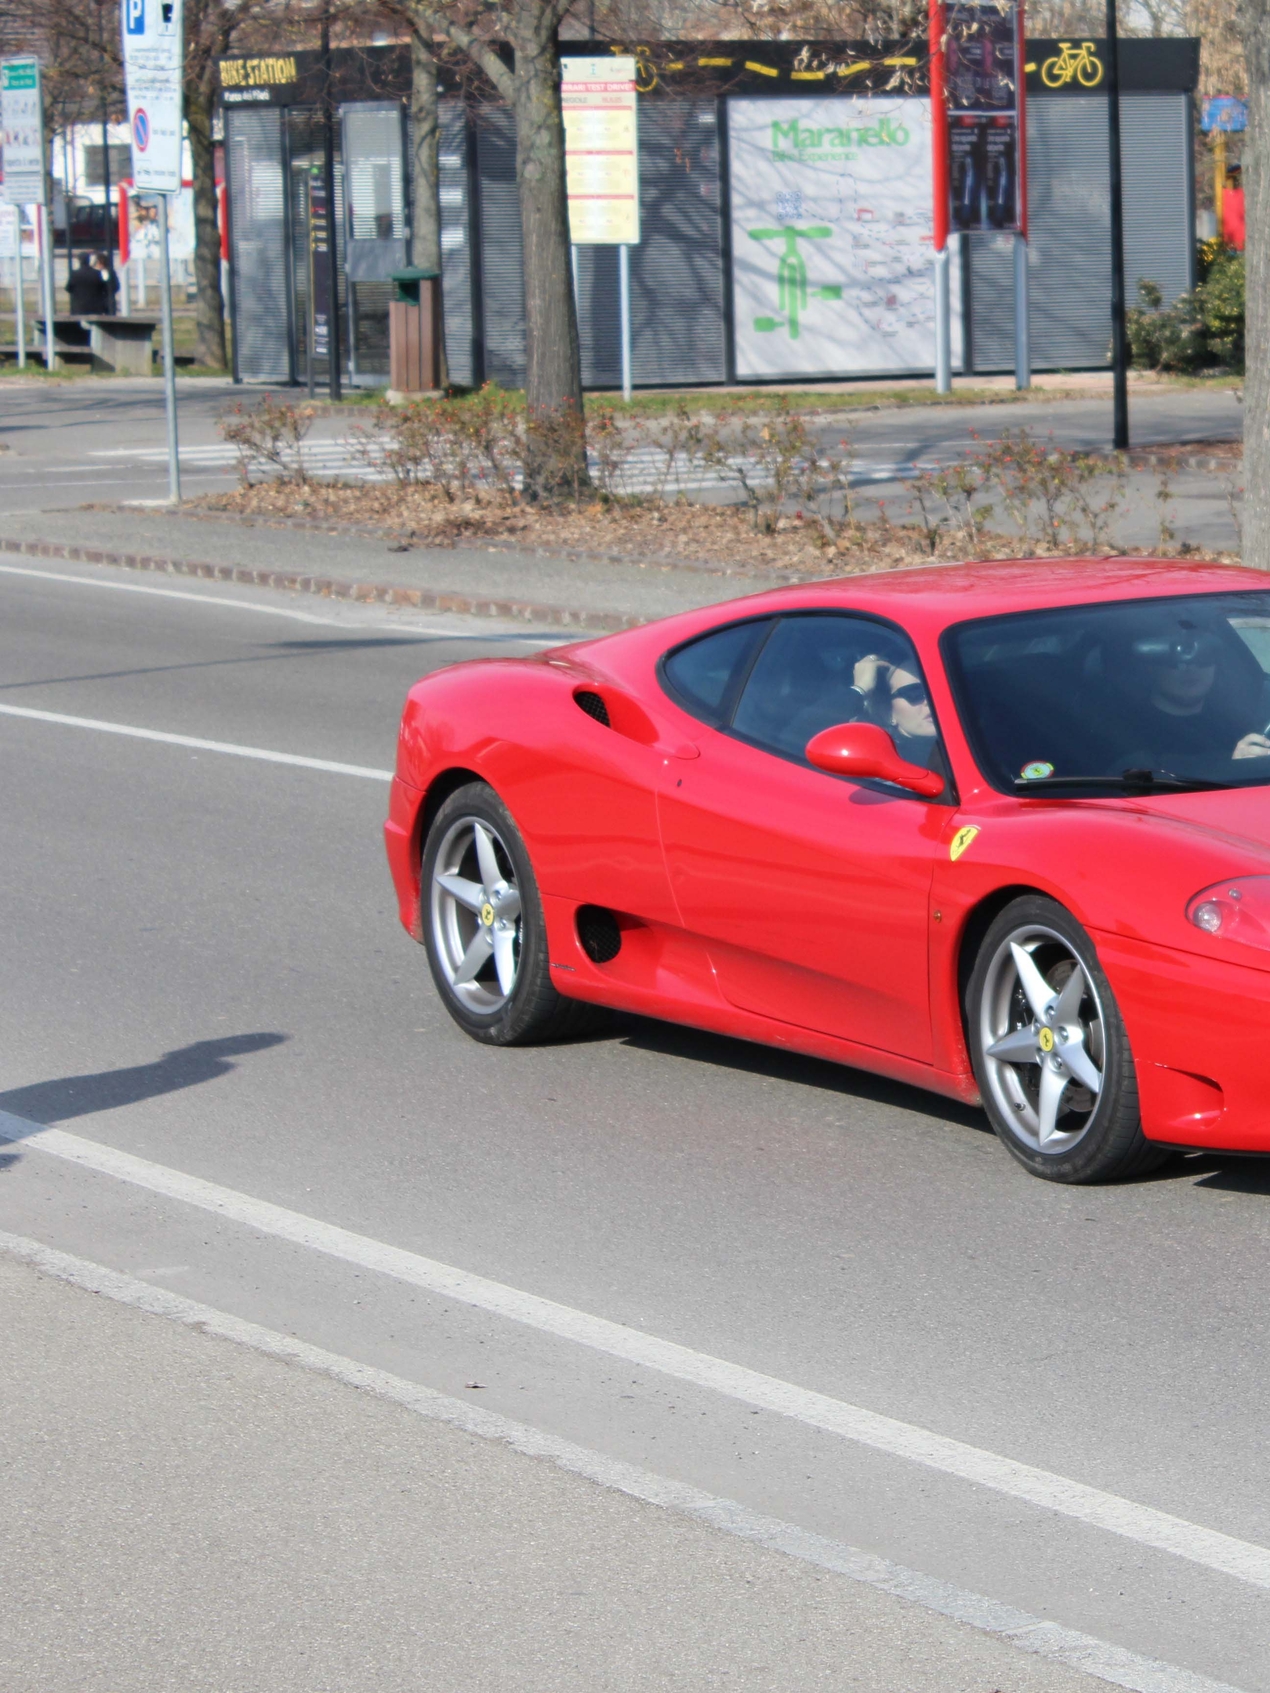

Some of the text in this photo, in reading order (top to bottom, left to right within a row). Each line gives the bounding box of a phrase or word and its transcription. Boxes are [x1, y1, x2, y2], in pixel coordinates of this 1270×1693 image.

[129, 0, 142, 29] P
[219, 56, 296, 87] BIKE STATION
[587, 84, 605, 92] TEST
[771, 117, 911, 149] Maranello
[772, 151, 859, 163] Bike Experience
